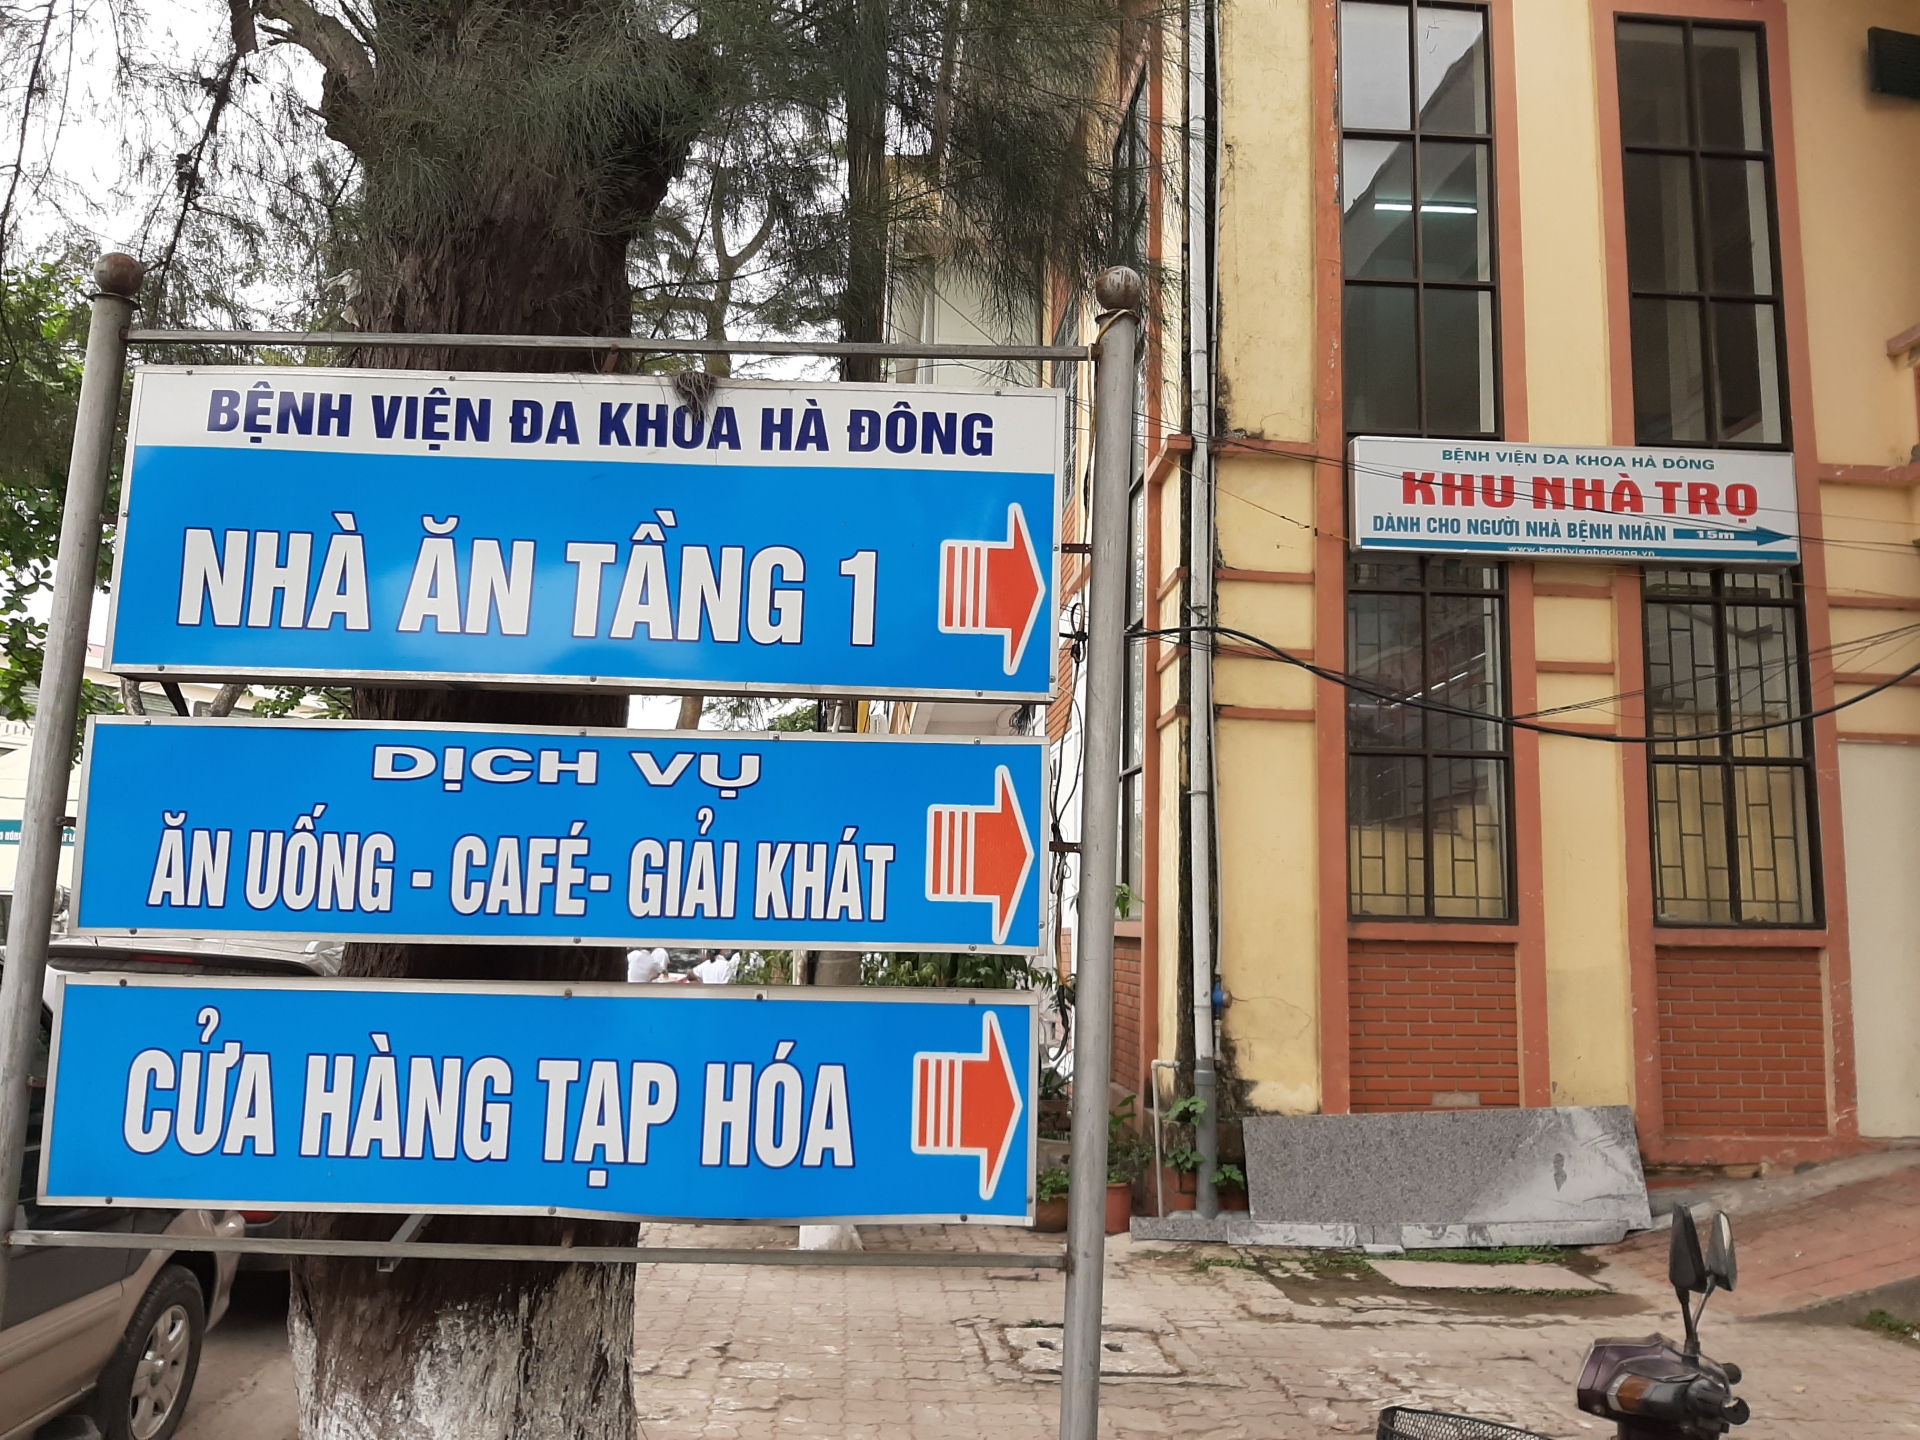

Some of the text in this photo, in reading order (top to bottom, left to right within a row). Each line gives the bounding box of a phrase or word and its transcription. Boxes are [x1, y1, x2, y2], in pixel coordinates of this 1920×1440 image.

[206, 381, 994, 456] BỆNH VIỆN ĐA KHOA HÀ ĐÔNG
[1442, 448, 1715, 470] BỆNH VIỆN ĐA KHOA HÀ ĐÔNG
[1402, 471, 1758, 523] KHU NHÀ TRỌ
[1373, 512, 1666, 542] DÀNH CHO NGƯỜI NHÀ BỆNH NHÂN
[1696, 530, 1735, 540] 15m
[176, 508, 878, 647] NHÀ ĂN TẦNG 1
[372, 745, 761, 799] DỊCH VỤ
[147, 812, 231, 907] ĂN
[244, 803, 396, 913] UỐNG
[627, 807, 739, 919] GIẢI
[752, 826, 896, 921] KHÁT
[122, 1007, 855, 1188] CỬA HÀNG TẠP HÓA
